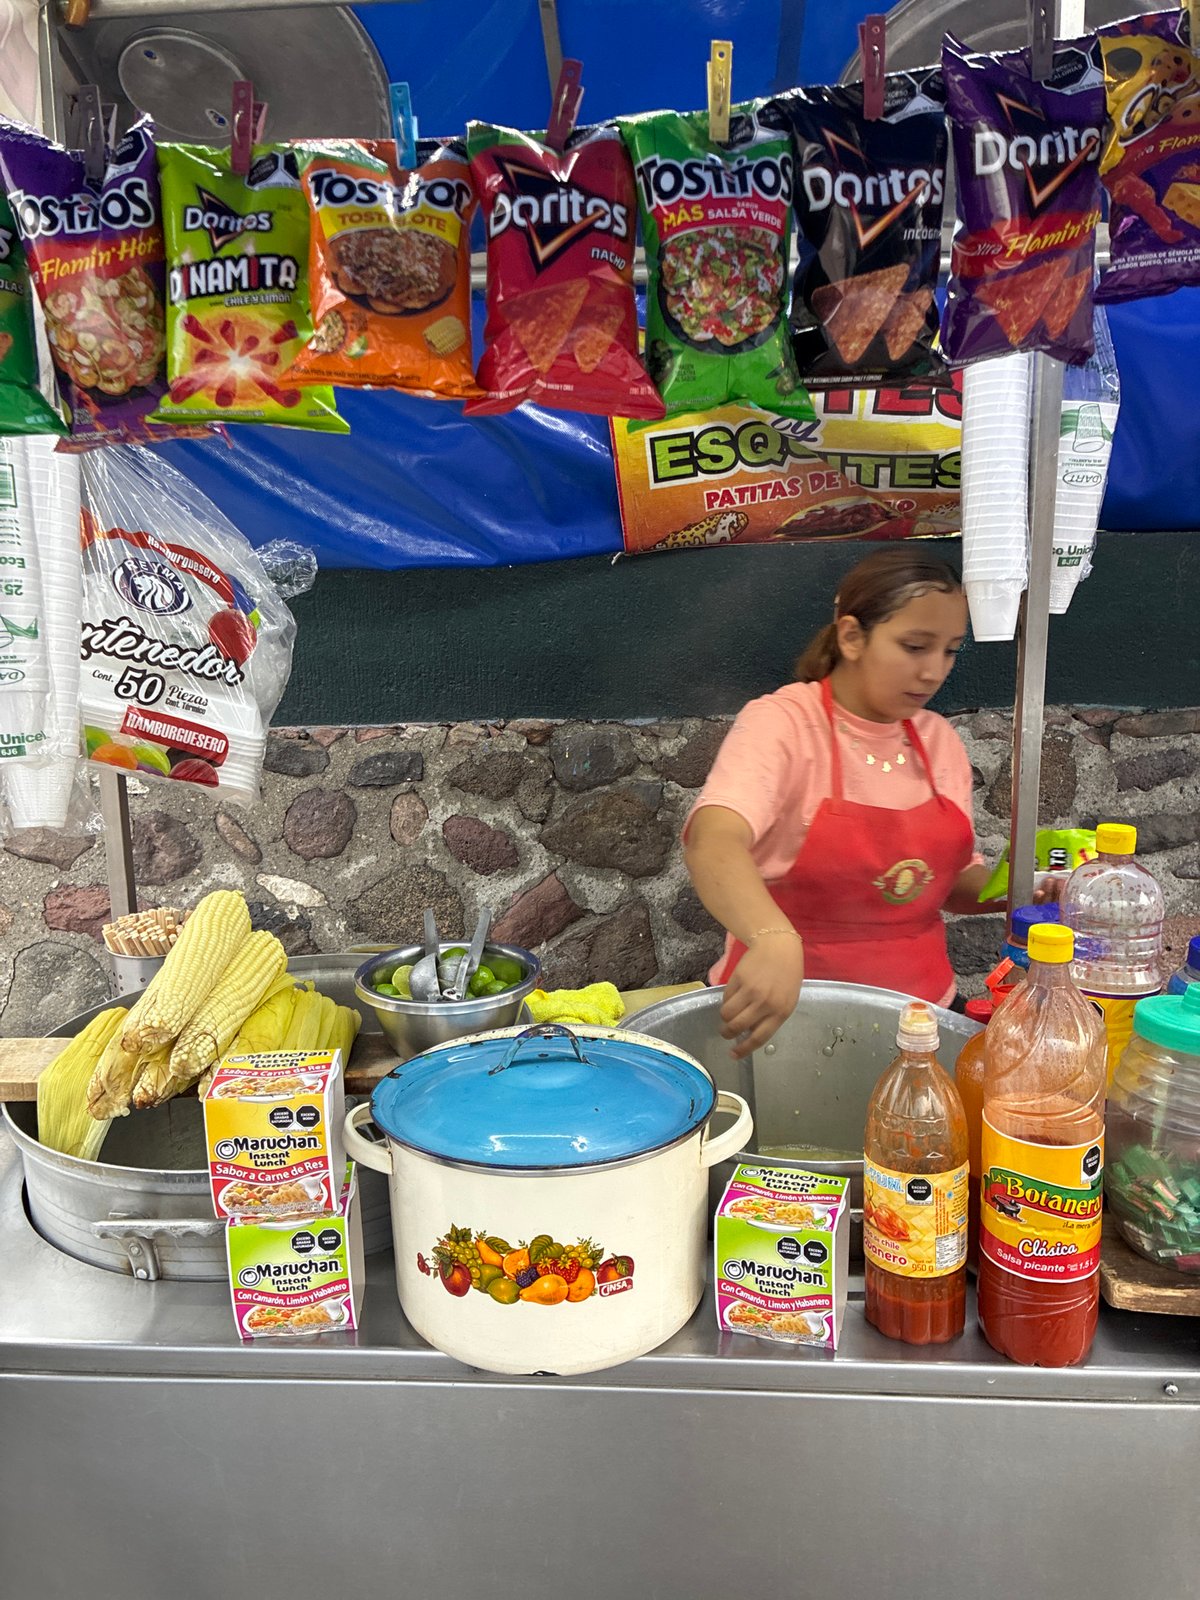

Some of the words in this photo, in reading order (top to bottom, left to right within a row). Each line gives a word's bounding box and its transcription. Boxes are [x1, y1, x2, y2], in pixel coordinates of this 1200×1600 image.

[974, 126, 1102, 176] Dorito
[803, 166, 944, 212] Doritos
[185, 207, 271, 231] Doritos
[489, 186, 628, 238] Doritos
[663, 203, 704, 233] MÁS
[707, 207, 747, 220] SALSA
[750, 210, 782, 230] VERDE
[117, 237, 159, 262] Hot
[170, 256, 299, 304] DINAMITA
[1067, 474, 1099, 483] DART
[704, 476, 802, 512] PATITAS
[808, 470, 842, 494] DE
[123, 559, 184, 592] REYMA
[4, 584, 23, 596] 25
[92, 669, 114, 683] Cont.
[114, 666, 165, 705] 50
[169, 684, 209, 707] Piezas
[126, 712, 227, 754] HAMBURGUESERO
[247, 1051, 328, 1061] Maruchan
[222, 1067, 251, 1076] Sabor
[259, 1069, 289, 1077] Carne
[293, 1066, 305, 1074] de
[234, 1135, 319, 1151] Maruchan
[249, 1151, 290, 1160] Instant
[254, 1158, 287, 1167] Lunch
[216, 1163, 247, 1179] Sabor
[249, 1172, 255, 1180] a
[257, 1171, 289, 1182] Carne
[291, 1165, 304, 1177] de
[304, 1159, 324, 1171] Res
[759, 1168, 840, 1187] Maruchan
[991, 1172, 1002, 1183] La
[732, 1182, 746, 1191] Con
[775, 1191, 797, 1201] Limón
[761, 1176, 818, 1190] Instant
[765, 1182, 810, 1193] Lunch
[881, 1239, 900, 1251] chile
[1018, 1239, 1078, 1258] Clásica
[257, 1259, 339, 1277] Maruchan
[911, 1264, 927, 1272] 950
[928, 1265, 934, 1273] g
[996, 1247, 1022, 1266] Salsa
[1024, 1260, 1065, 1273] picante
[272, 1275, 311, 1286] Instant
[741, 1260, 824, 1286] Maruchan
[277, 1283, 308, 1292] Lunch
[755, 1278, 795, 1290] Instant
[759, 1285, 791, 1297] Lunch
[237, 1291, 252, 1300] Con
[252, 1292, 286, 1306] Camarón,
[286, 1294, 309, 1305] Limón
[314, 1283, 347, 1299] Habanero
[721, 1282, 735, 1293] Con
[735, 1286, 767, 1308] Camarón,
[768, 1297, 790, 1310] Limón
[795, 1296, 830, 1308] Habanero
